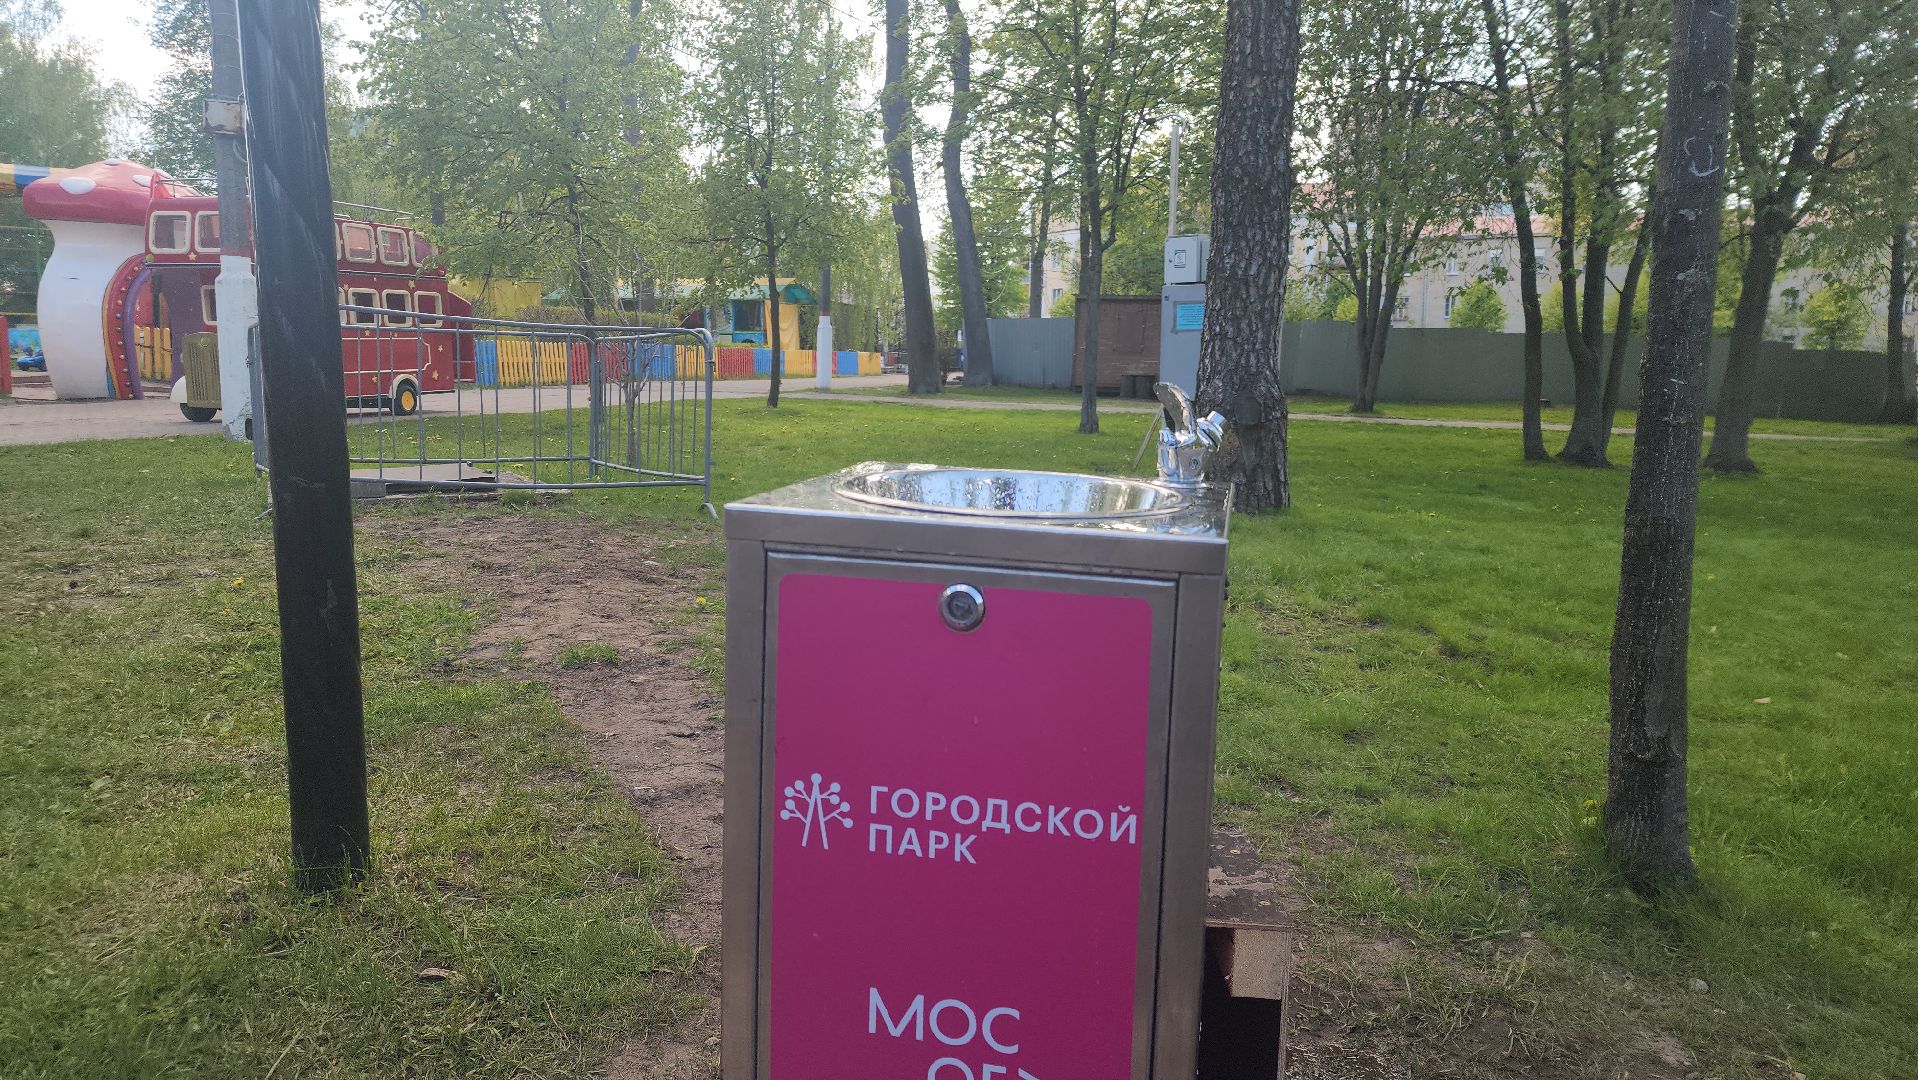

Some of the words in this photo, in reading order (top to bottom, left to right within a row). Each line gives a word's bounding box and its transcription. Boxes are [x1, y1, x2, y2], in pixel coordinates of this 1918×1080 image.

[868, 822, 978, 865] ПАРК
[870, 785, 1137, 845] ГОРОДСКОЙ
[868, 986, 1020, 1055] МОС
